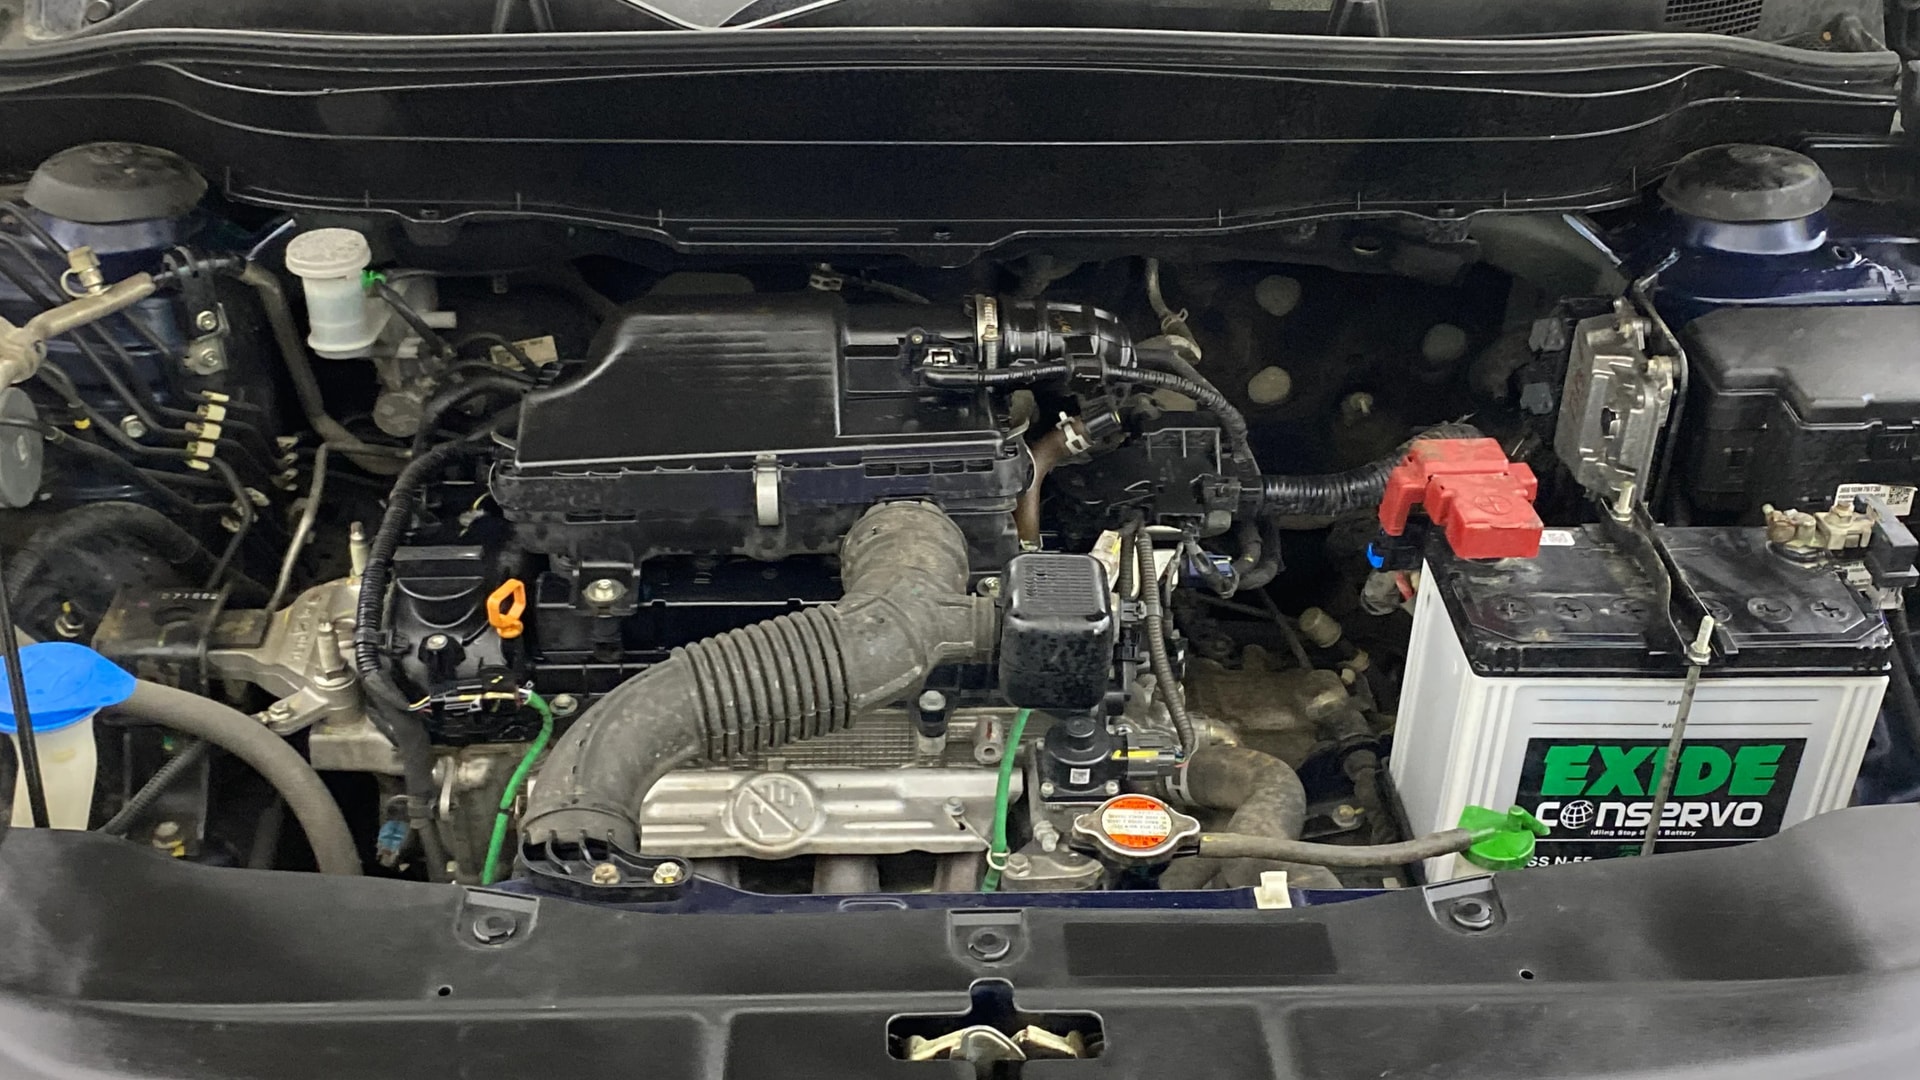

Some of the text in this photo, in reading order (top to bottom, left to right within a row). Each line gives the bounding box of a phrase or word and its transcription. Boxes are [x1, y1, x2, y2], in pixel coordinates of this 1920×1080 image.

[1540, 745, 1786, 796] EXIDE
[1535, 800, 1763, 829] CONSERVO
[1617, 829, 1637, 837] Stop
[1664, 829, 1696, 837] Battery
